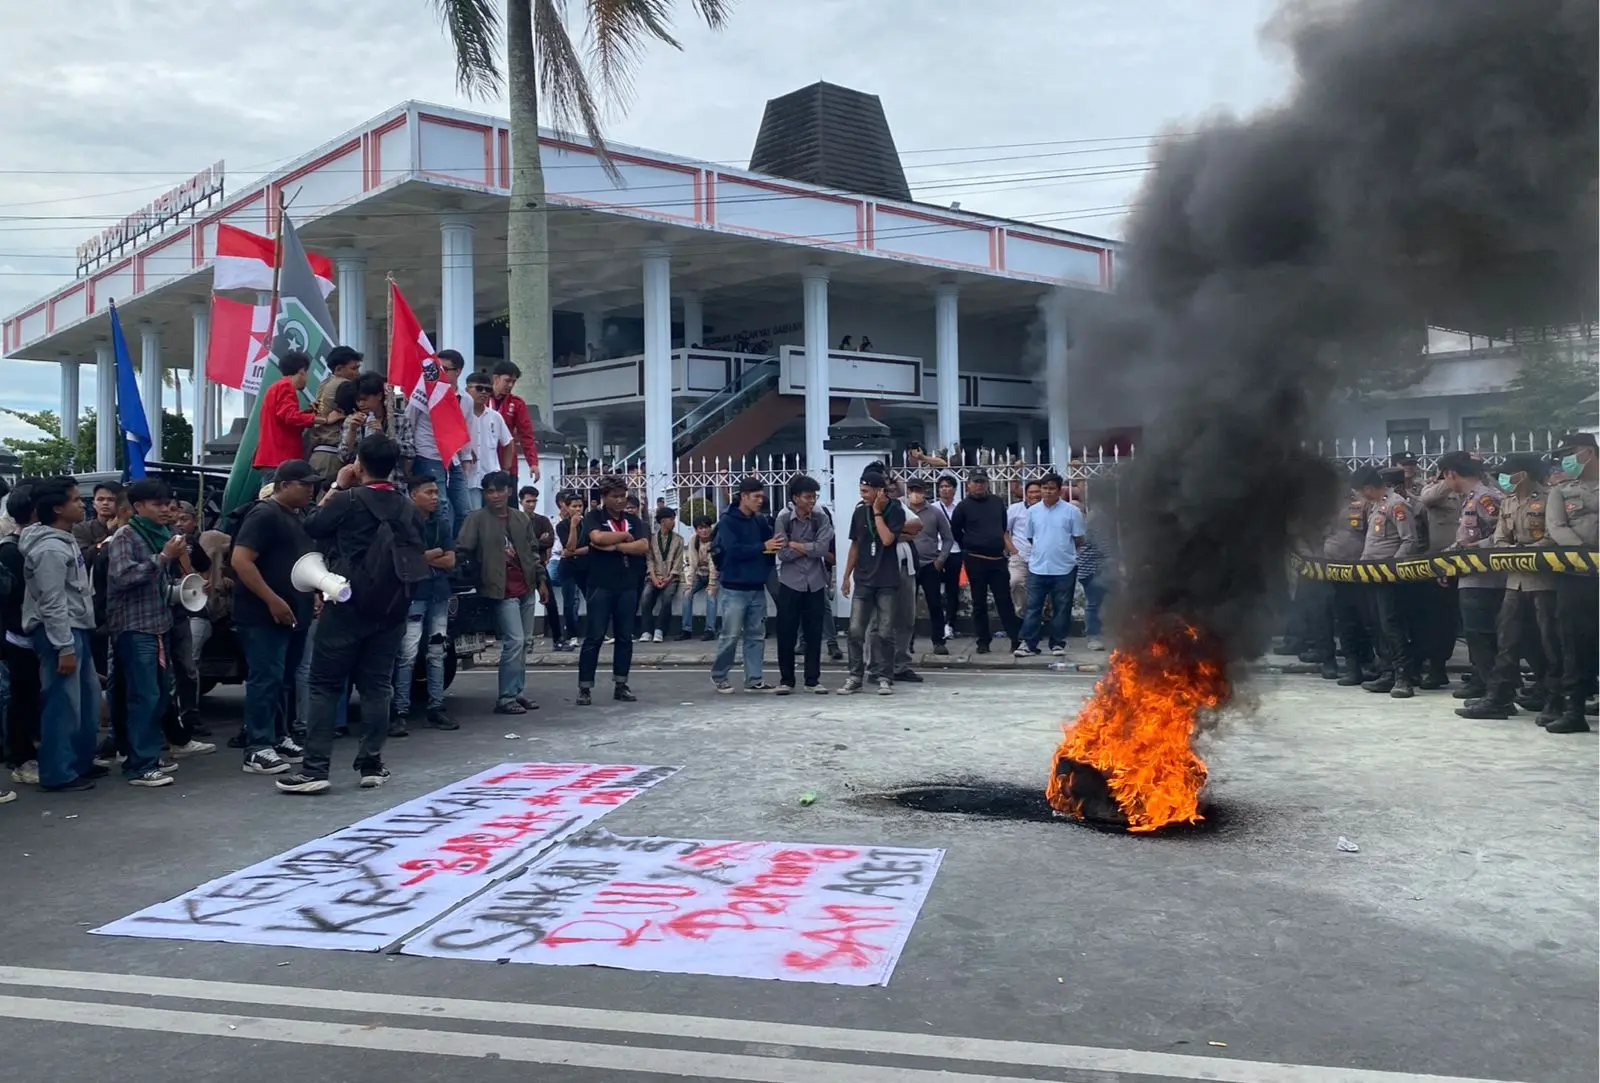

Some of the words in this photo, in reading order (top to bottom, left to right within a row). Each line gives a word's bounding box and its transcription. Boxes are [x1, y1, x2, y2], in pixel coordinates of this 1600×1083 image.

[1398, 563, 1432, 580] POLISI
[1491, 556, 1537, 571] POLISI
[131, 785, 533, 926] KEMBALIKAN
[822, 849, 932, 901] ASET
[433, 859, 620, 953] SAHKAN
[540, 881, 697, 948] RUU
